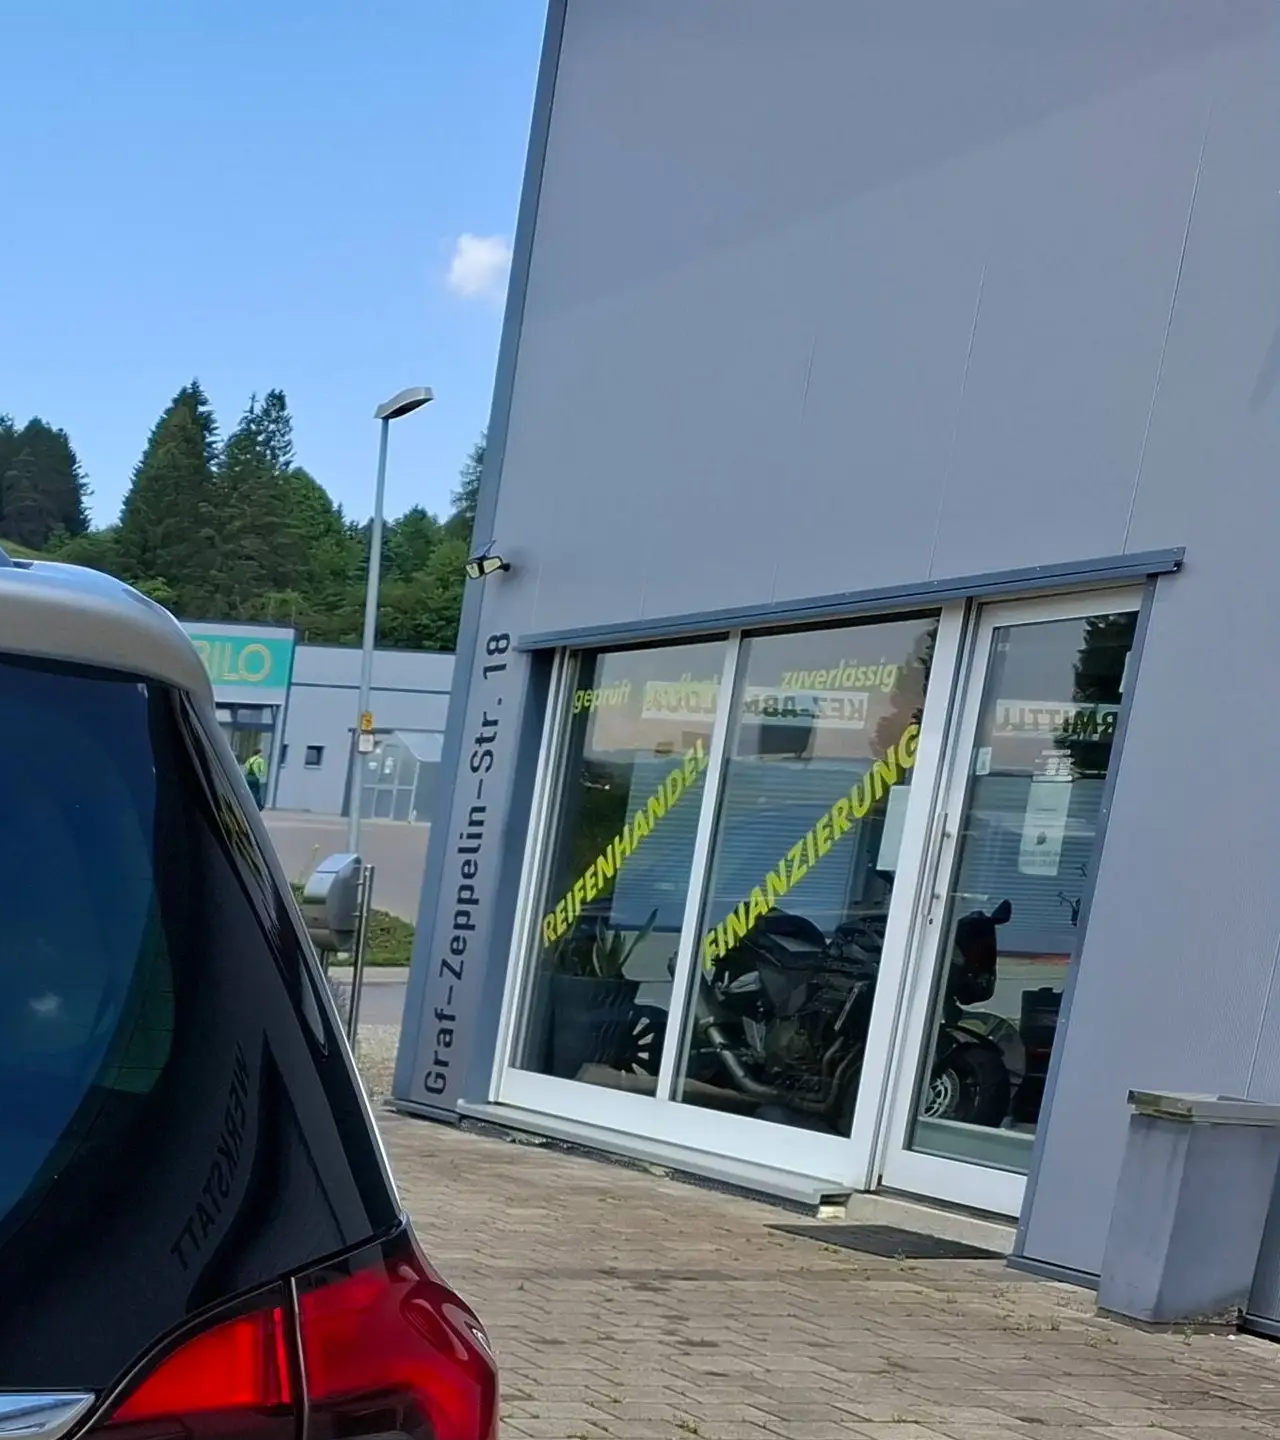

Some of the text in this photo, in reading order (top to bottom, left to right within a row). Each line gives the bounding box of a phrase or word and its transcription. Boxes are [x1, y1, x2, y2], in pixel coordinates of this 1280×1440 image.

[573, 679, 630, 714] geprüft
[781, 656, 898, 692] zuverlässig
[423, 631, 511, 1096] Graf-Zeppelin-Str. 18
[542, 737, 709, 948] REIFENHANDEL
[702, 723, 921, 972] FINANZIERUNG
